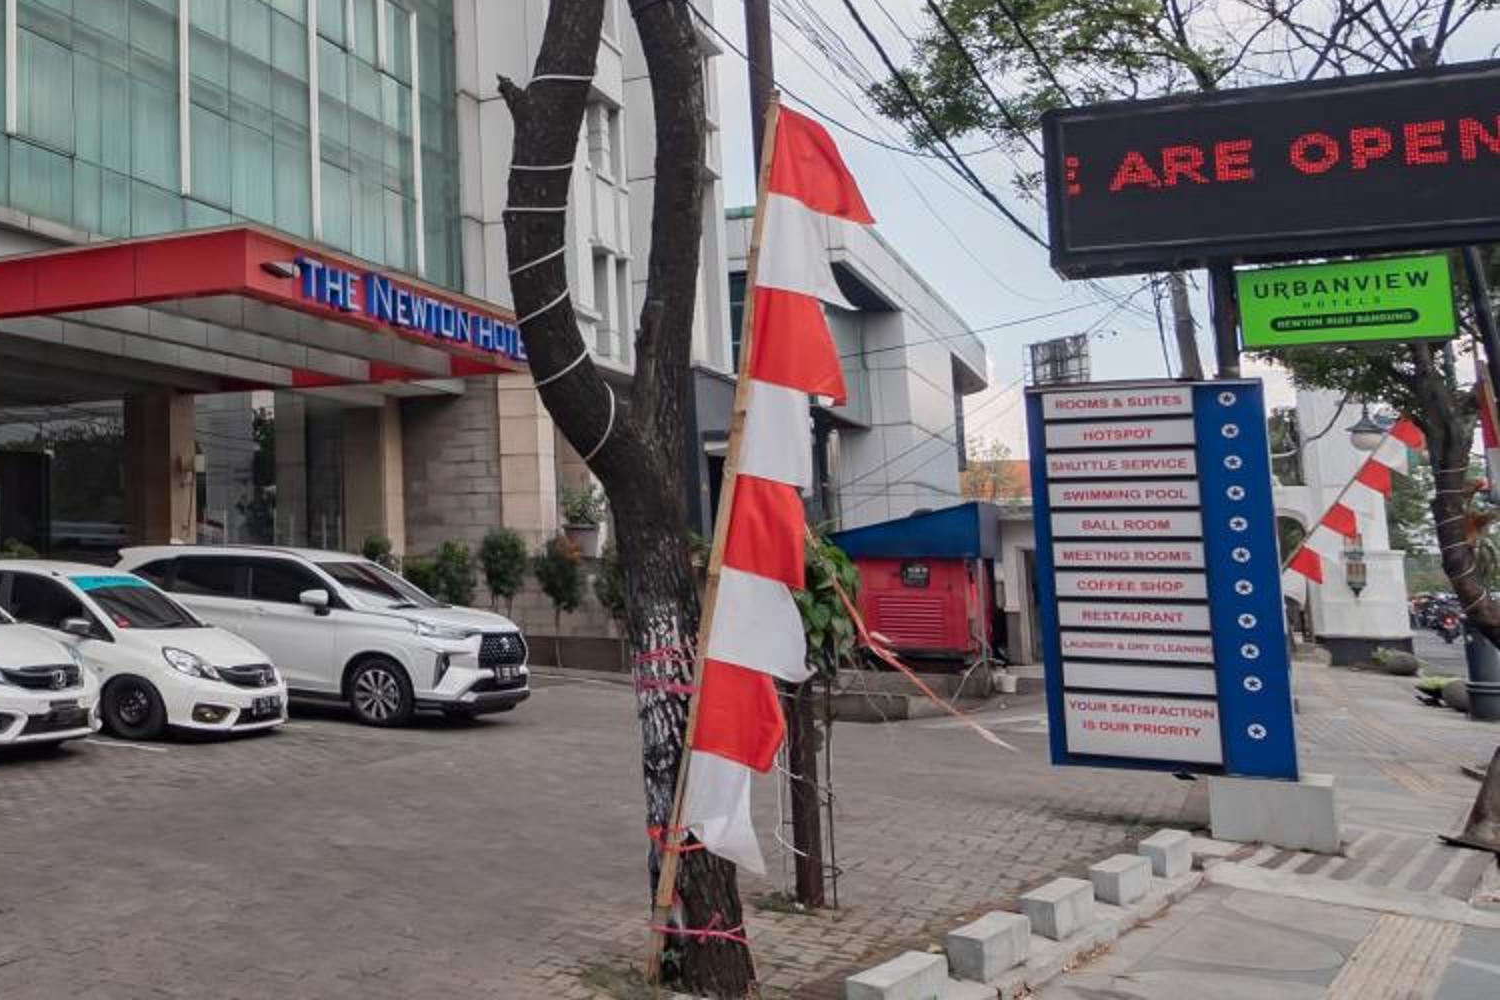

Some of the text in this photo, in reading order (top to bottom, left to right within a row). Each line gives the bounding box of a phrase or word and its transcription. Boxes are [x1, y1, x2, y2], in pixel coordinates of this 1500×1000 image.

[1109, 139, 1255, 191] ARE
[1289, 115, 1500, 175] OPEN
[1253, 271, 1429, 300] URBANVIEW
[297, 256, 528, 361] THE NEWTON HOTE
[1302, 297, 1381, 309] HOTELS
[1055, 395, 1183, 410] ROOMS & SUITES
[1083, 428, 1155, 441] HOTSPOT
[1051, 457, 1188, 473] SHUTTLE SERVICE
[1063, 489, 1189, 501] SWIMMING POOL
[1082, 519, 1171, 531] BALL ROOM
[1063, 551, 1192, 561] MEETING ROOMS
[1076, 579, 1185, 592] COFFEE SHOP
[1082, 610, 1184, 623] RESTAURANT
[1063, 640, 1115, 650] LAUNDRY
[1154, 643, 1213, 655] CLEANING
[1069, 700, 1215, 719] YOUR SATISFACTION
[1083, 719, 1201, 737] IS OUR PRIORITY
